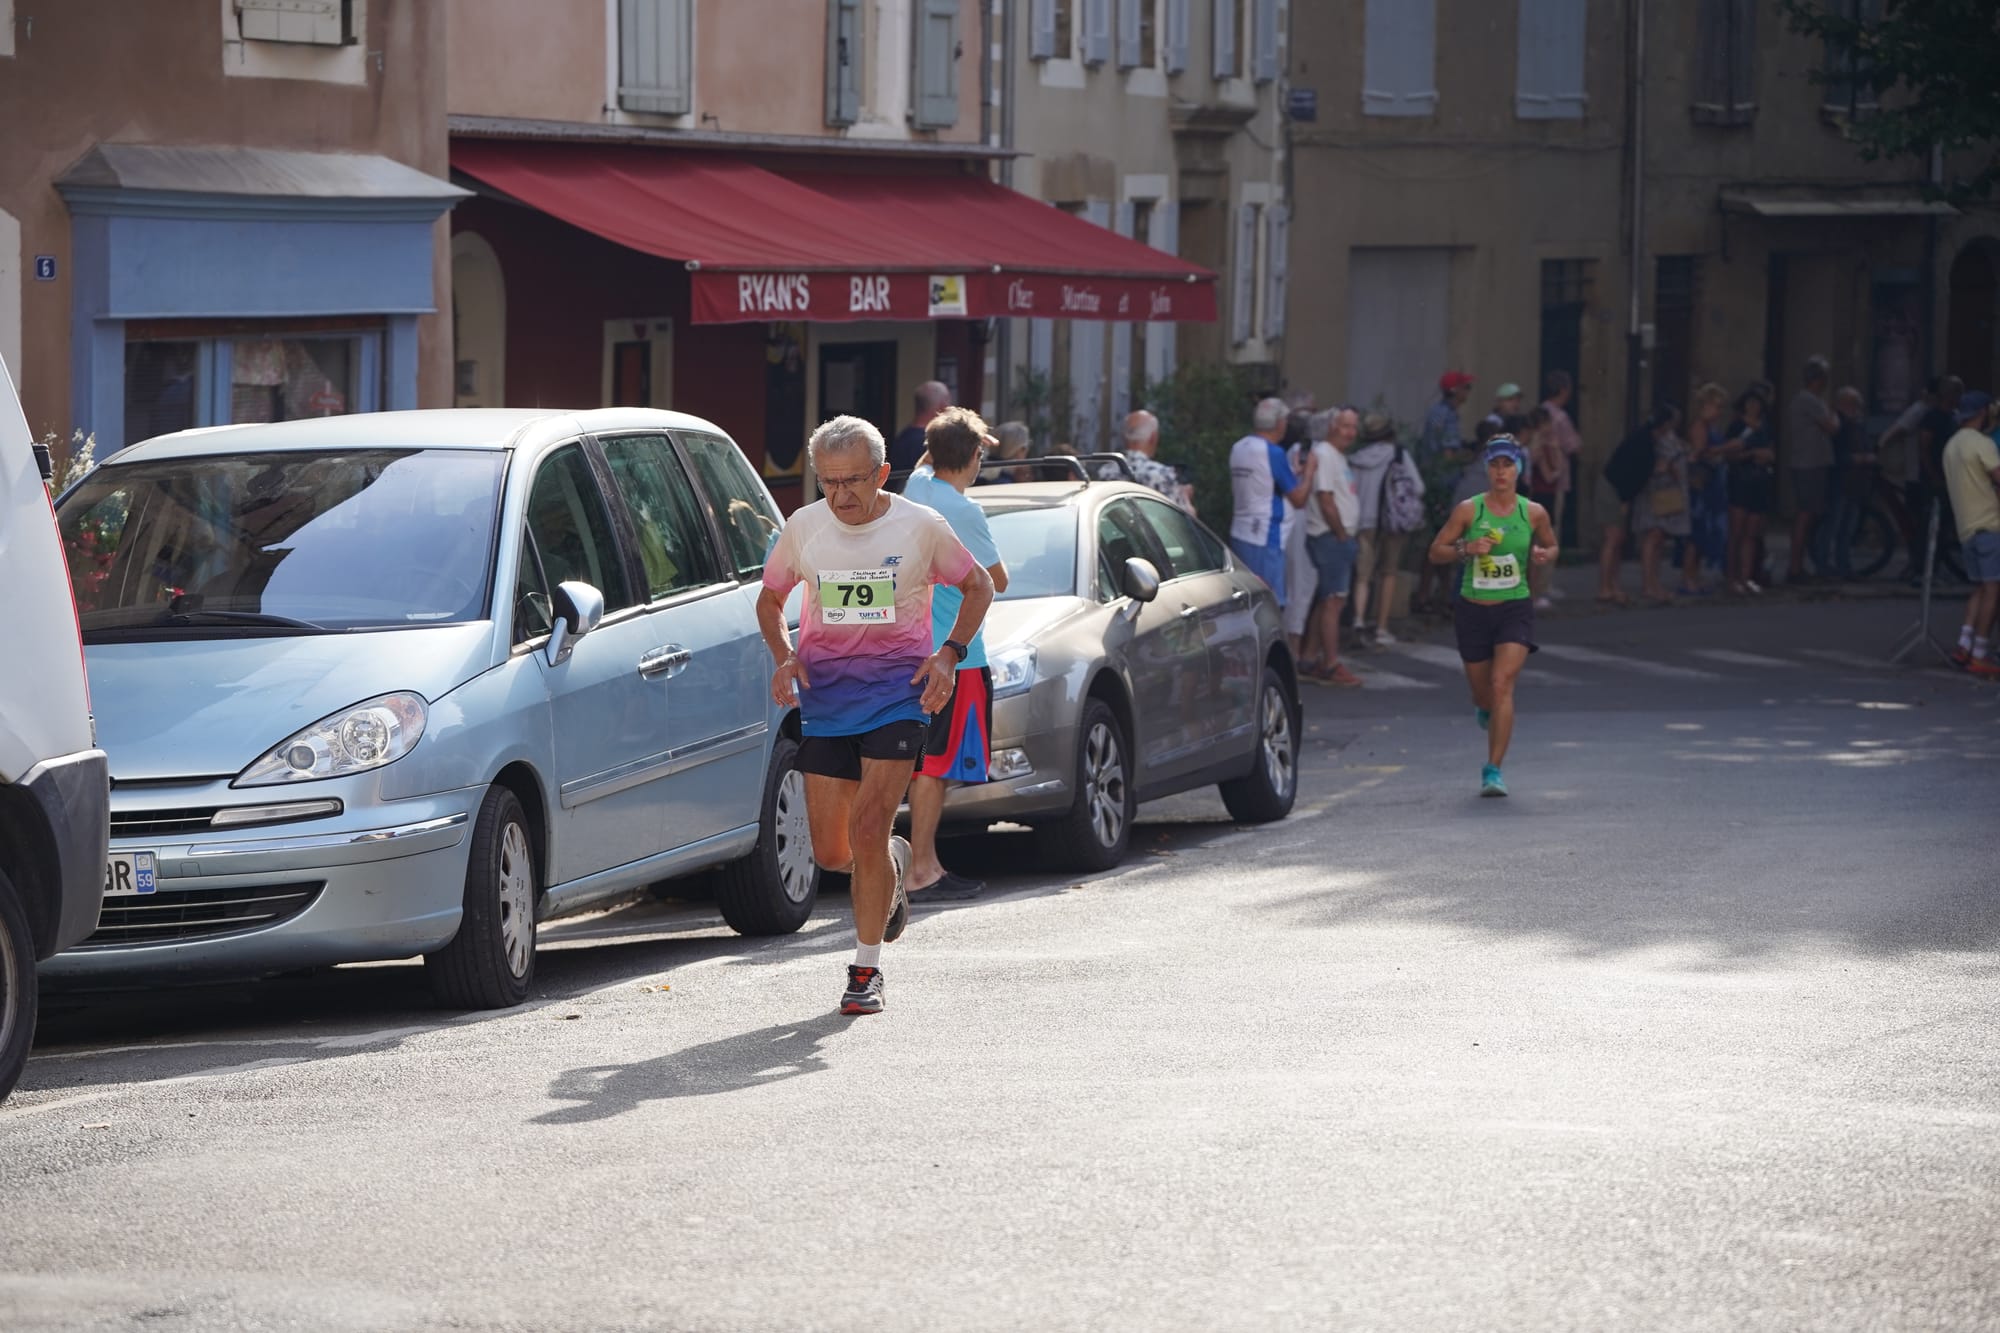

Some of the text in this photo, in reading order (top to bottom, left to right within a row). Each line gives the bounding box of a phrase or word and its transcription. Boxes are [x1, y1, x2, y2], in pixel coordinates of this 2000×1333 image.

[42, 260, 50, 277] 6
[738, 274, 810, 312] RYAN'S
[849, 275, 891, 312] BAR
[837, 584, 874, 607] 79
[137, 873, 153, 888] 59
